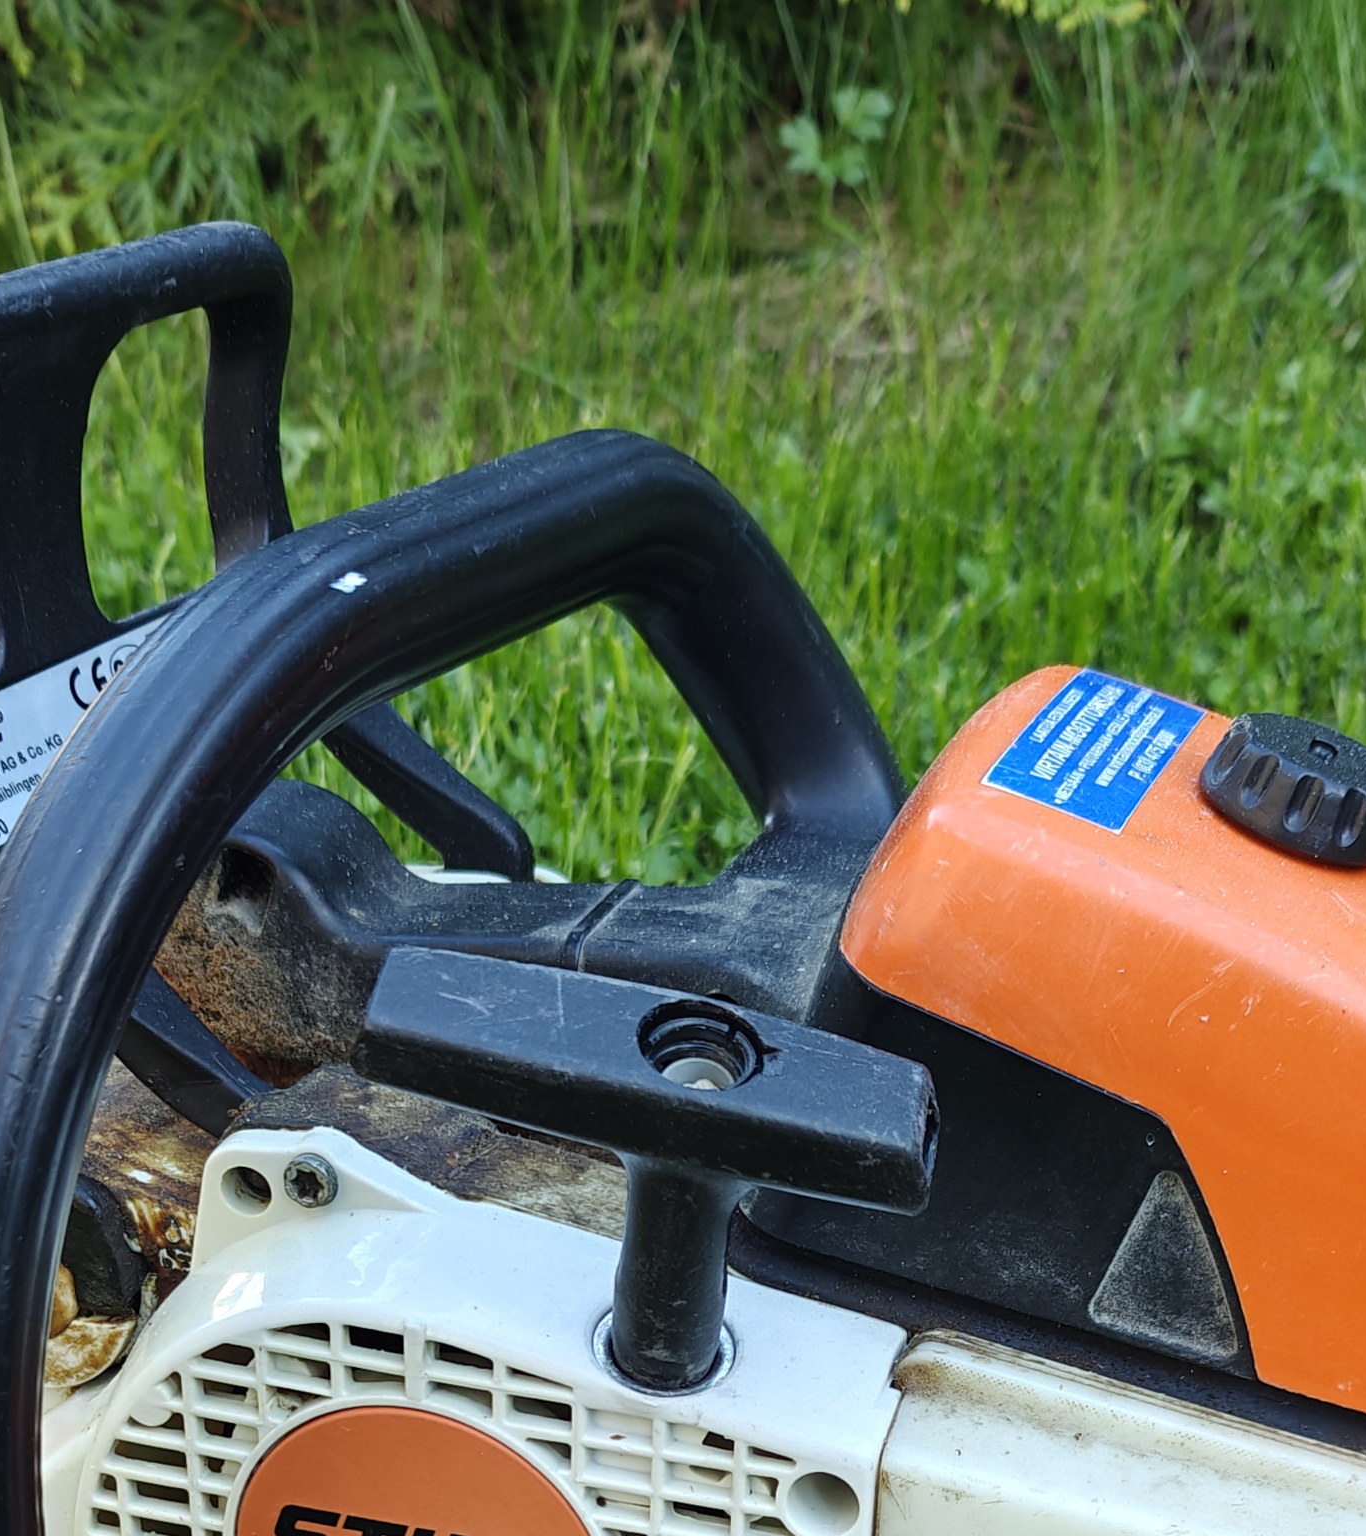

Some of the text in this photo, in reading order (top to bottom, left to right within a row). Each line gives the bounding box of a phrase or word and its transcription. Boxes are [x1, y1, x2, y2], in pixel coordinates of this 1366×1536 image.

[0, 756, 17, 774] AG
[17, 751, 27, 764] &
[44, 733, 63, 751] KG
